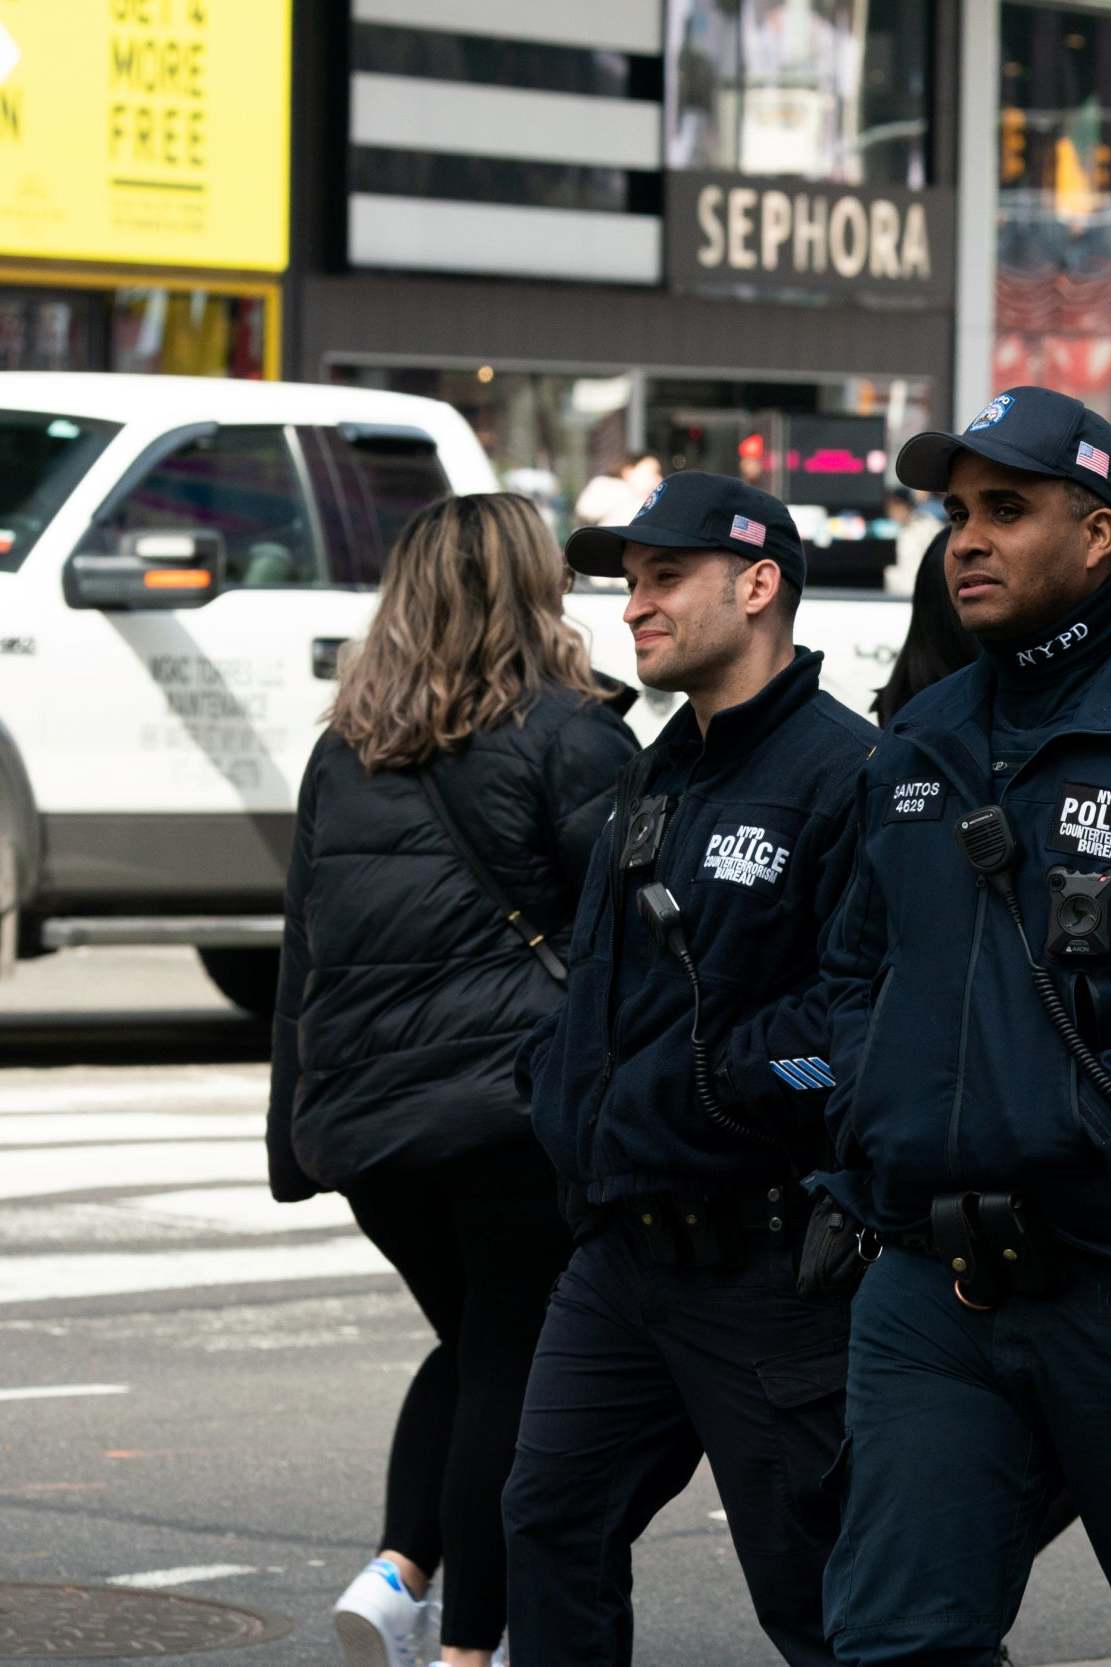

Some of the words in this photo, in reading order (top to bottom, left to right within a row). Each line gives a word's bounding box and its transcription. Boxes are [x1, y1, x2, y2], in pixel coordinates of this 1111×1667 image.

[110, 37, 204, 98] MORE
[109, 103, 204, 164] FREE
[697, 184, 932, 280] SEPHORA
[1016, 622, 1089, 667] NYPD
[893, 782, 940, 799] SANTOS
[895, 798, 925, 813] 4629
[736, 824, 765, 840] NYPD
[703, 854, 779, 885] COUNTERTERRORISM
[705, 834, 790, 874] POLICE
[713, 866, 756, 887] BUREAU
